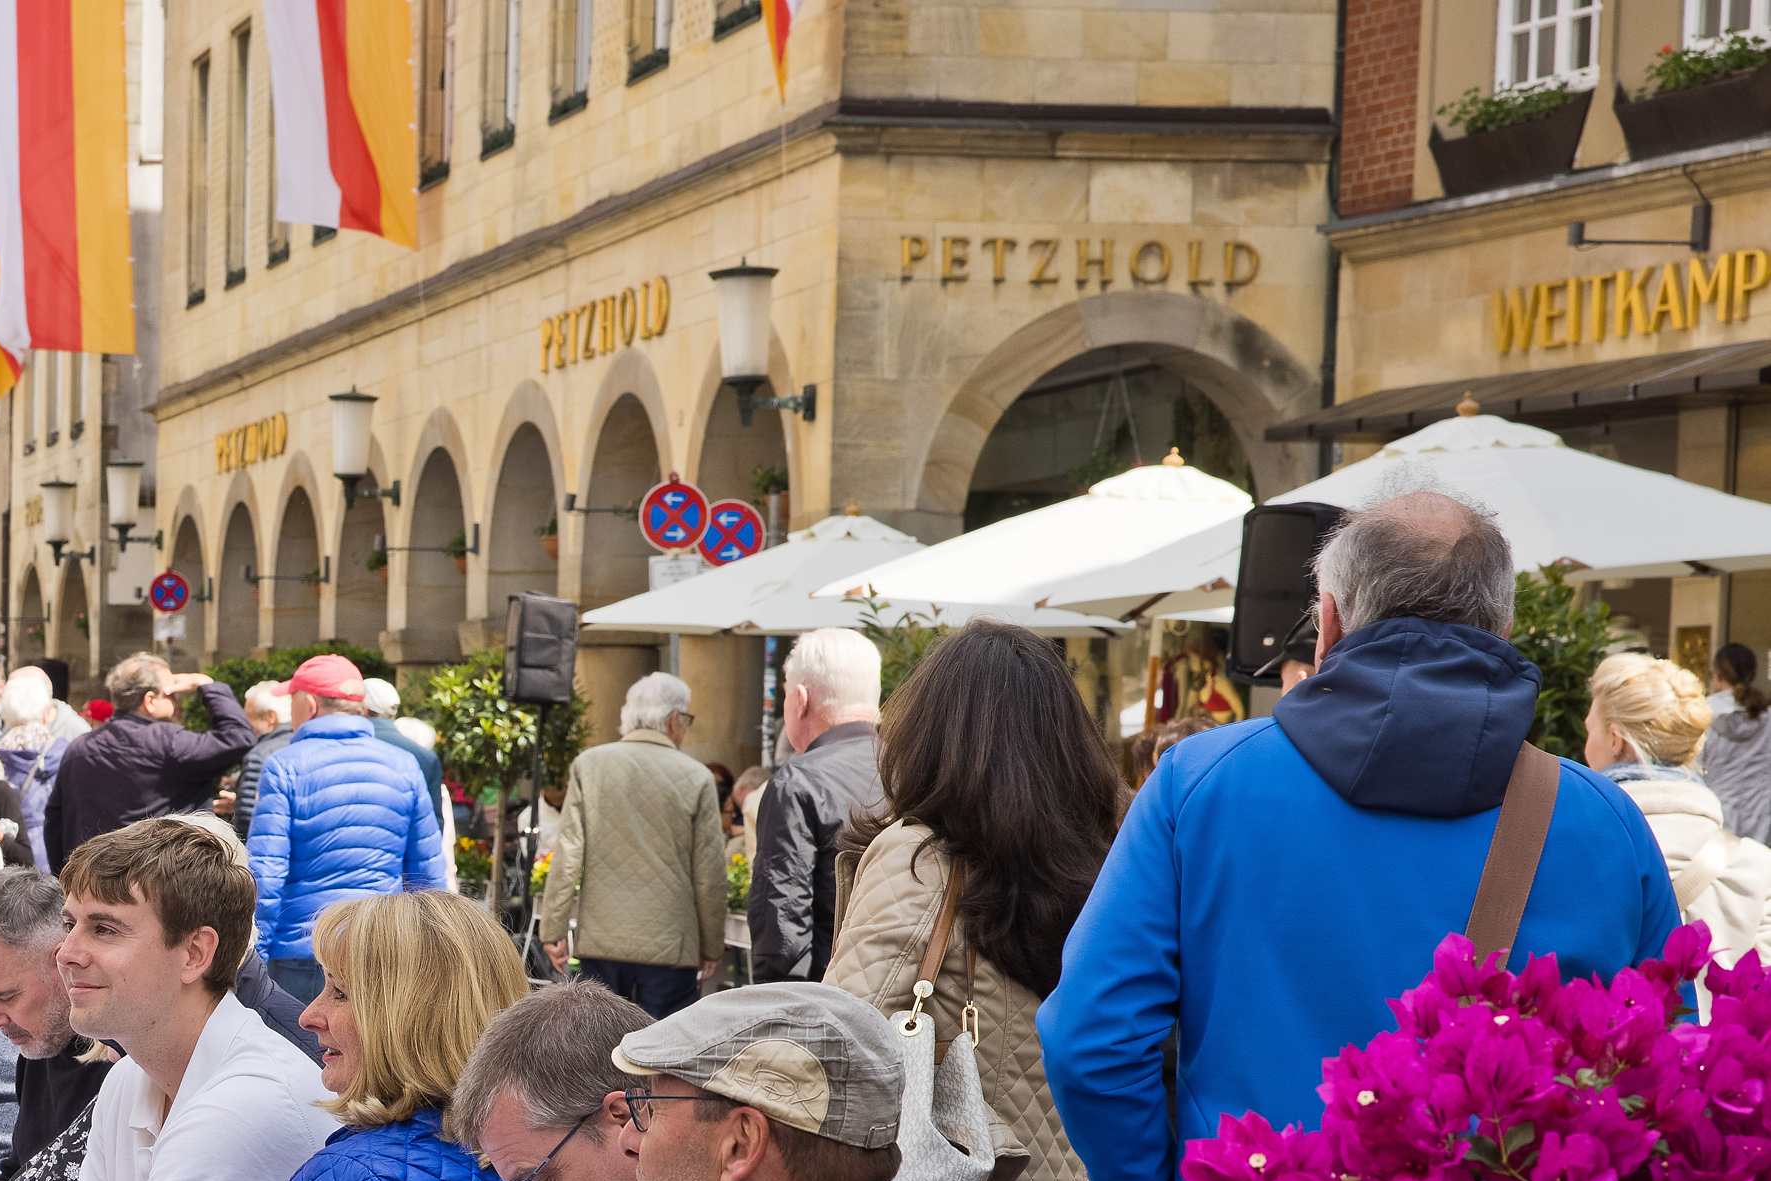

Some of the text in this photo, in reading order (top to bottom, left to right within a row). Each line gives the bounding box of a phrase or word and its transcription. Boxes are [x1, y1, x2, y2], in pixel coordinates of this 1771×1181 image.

[899, 235, 1262, 286] PETZHOLD
[1490, 249, 1770, 354] WEITKAMP
[540, 275, 670, 373] PETZHOLD
